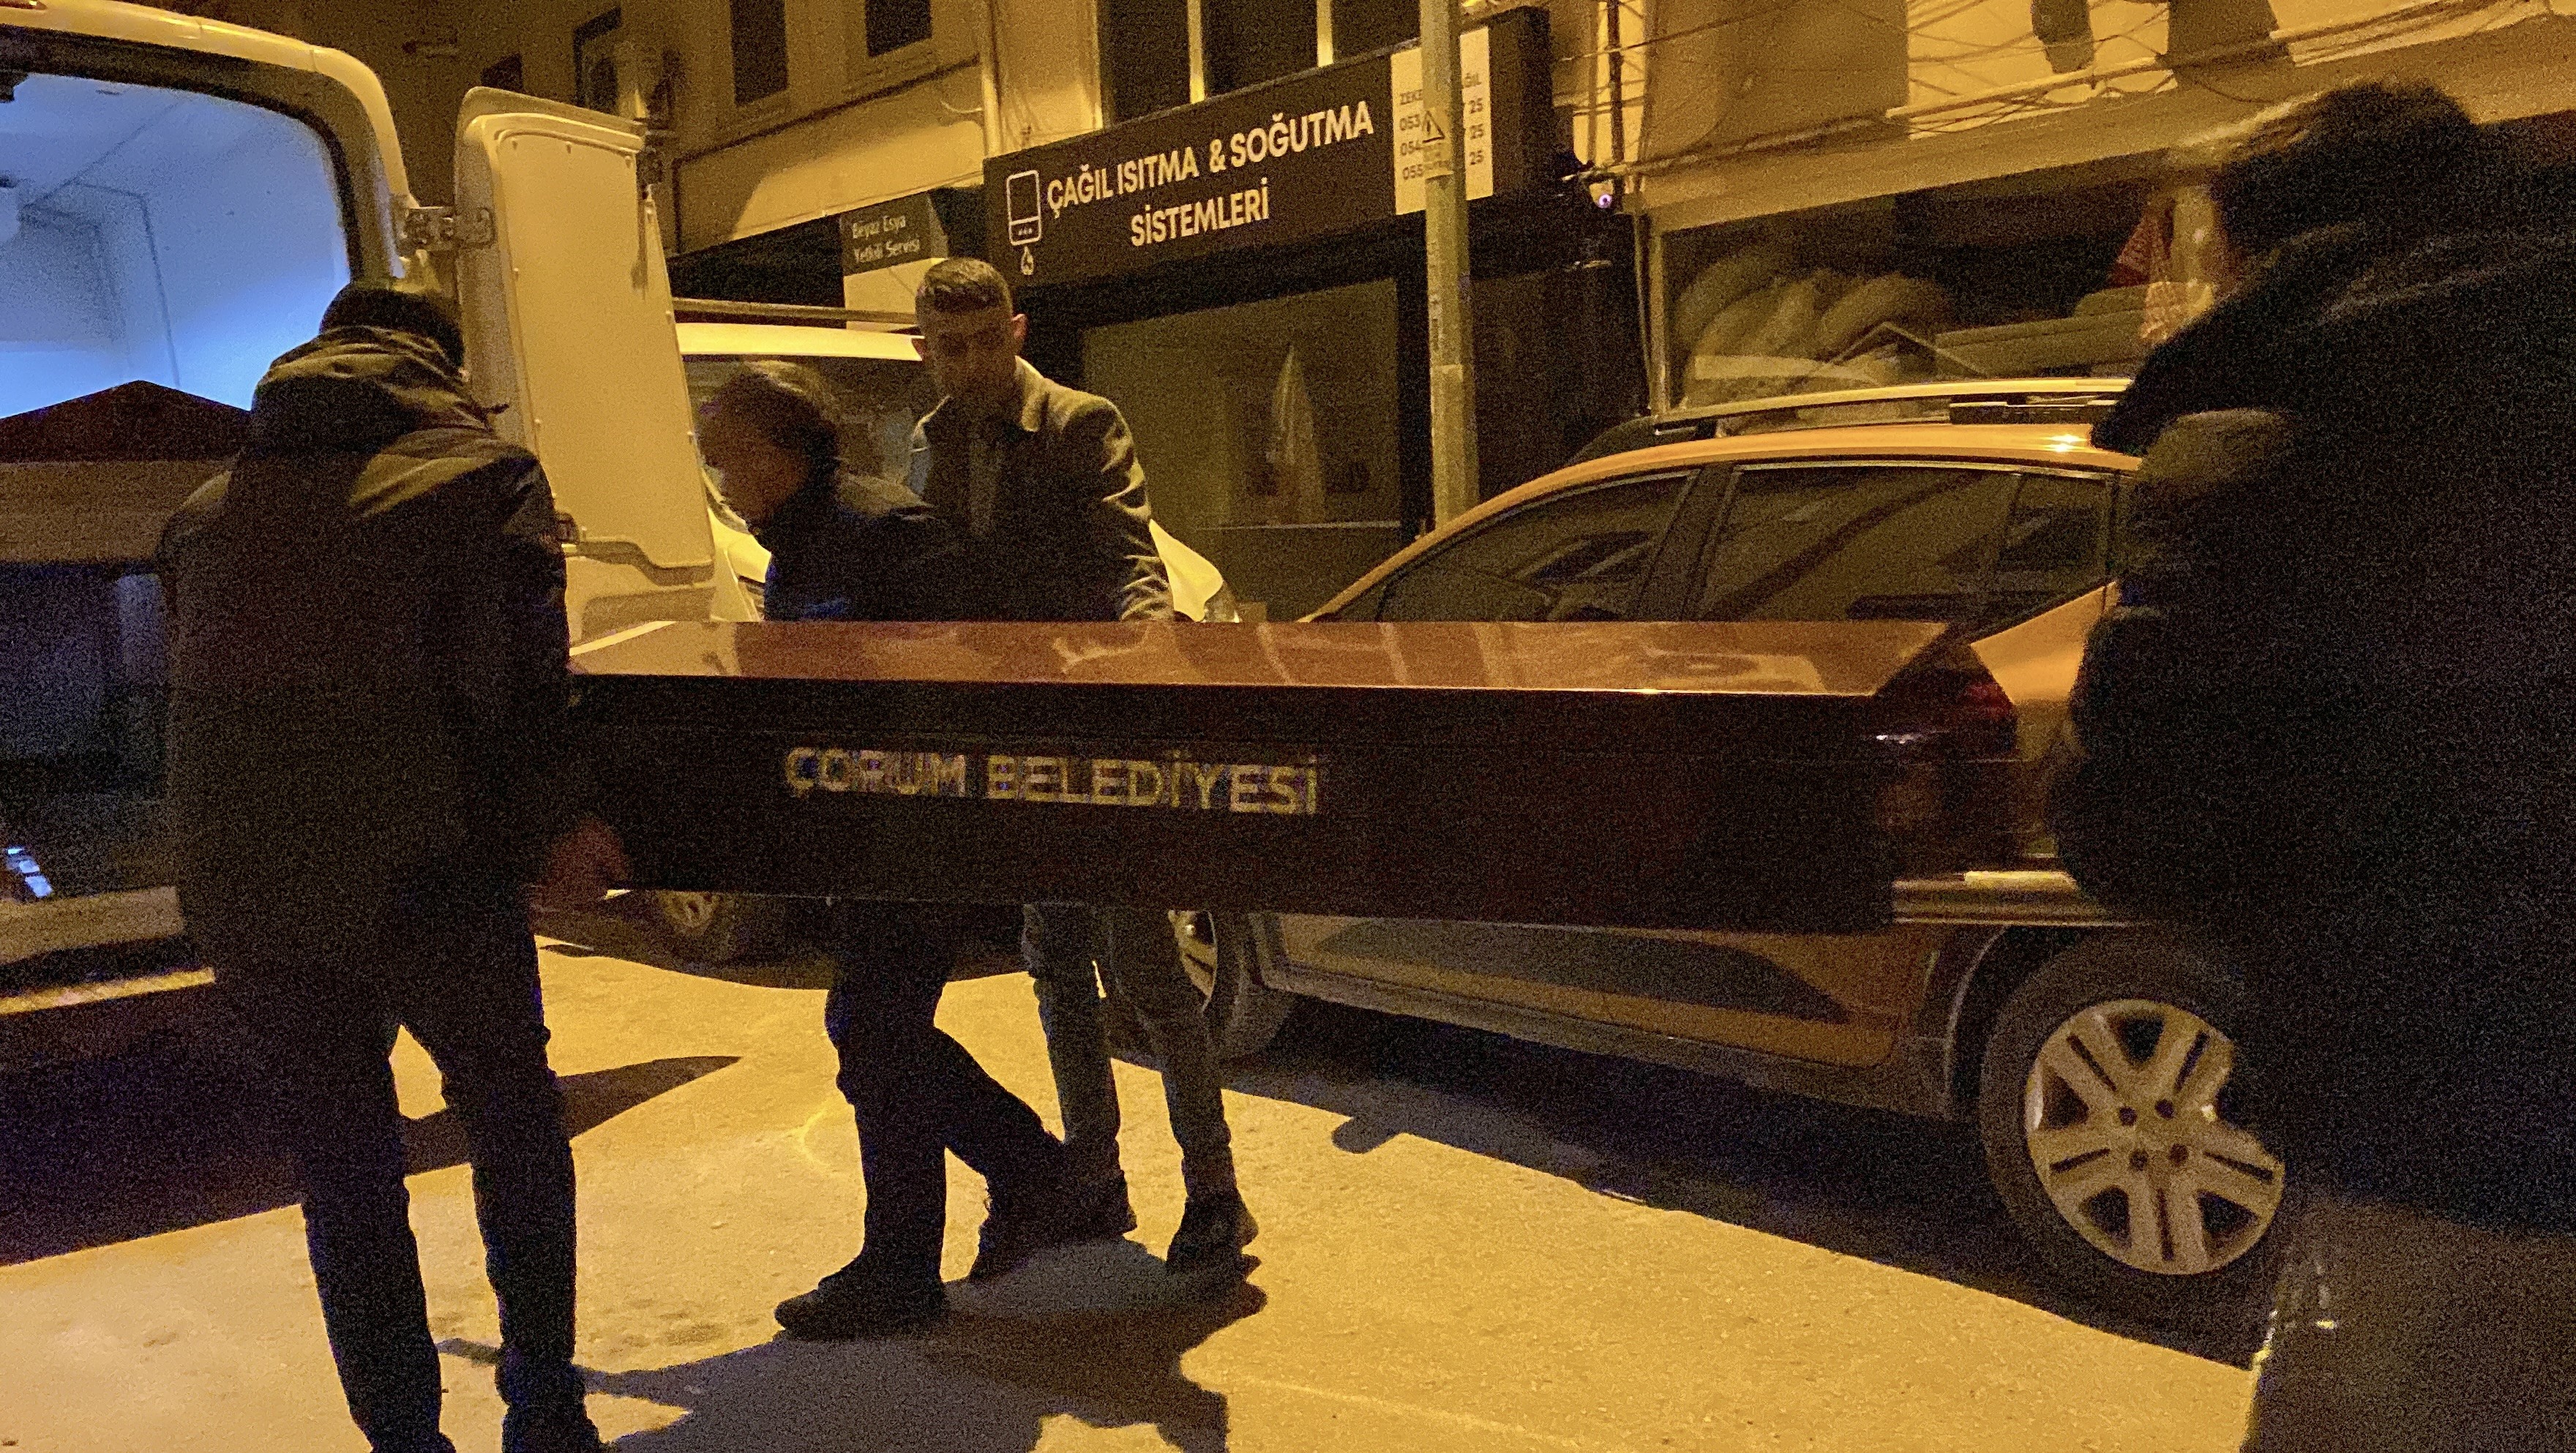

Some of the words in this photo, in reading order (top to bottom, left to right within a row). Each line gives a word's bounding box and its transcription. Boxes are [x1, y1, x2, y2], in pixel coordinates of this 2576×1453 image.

[1400, 89, 1424, 105] ZEKE
[1399, 113, 1420, 132] 053
[1400, 139, 1423, 157] 054
[1047, 162, 1114, 219] ÇAĞIL
[1117, 146, 1199, 195] ISITMA
[1209, 138, 1227, 173] &
[1230, 101, 1374, 168] SOĞUTMA
[1401, 162, 1424, 181] 055
[1131, 176, 1269, 247] SİSTEMLERİ
[785, 746, 966, 799] ÇORUM
[987, 749, 1317, 816] BELEDİYESİ
